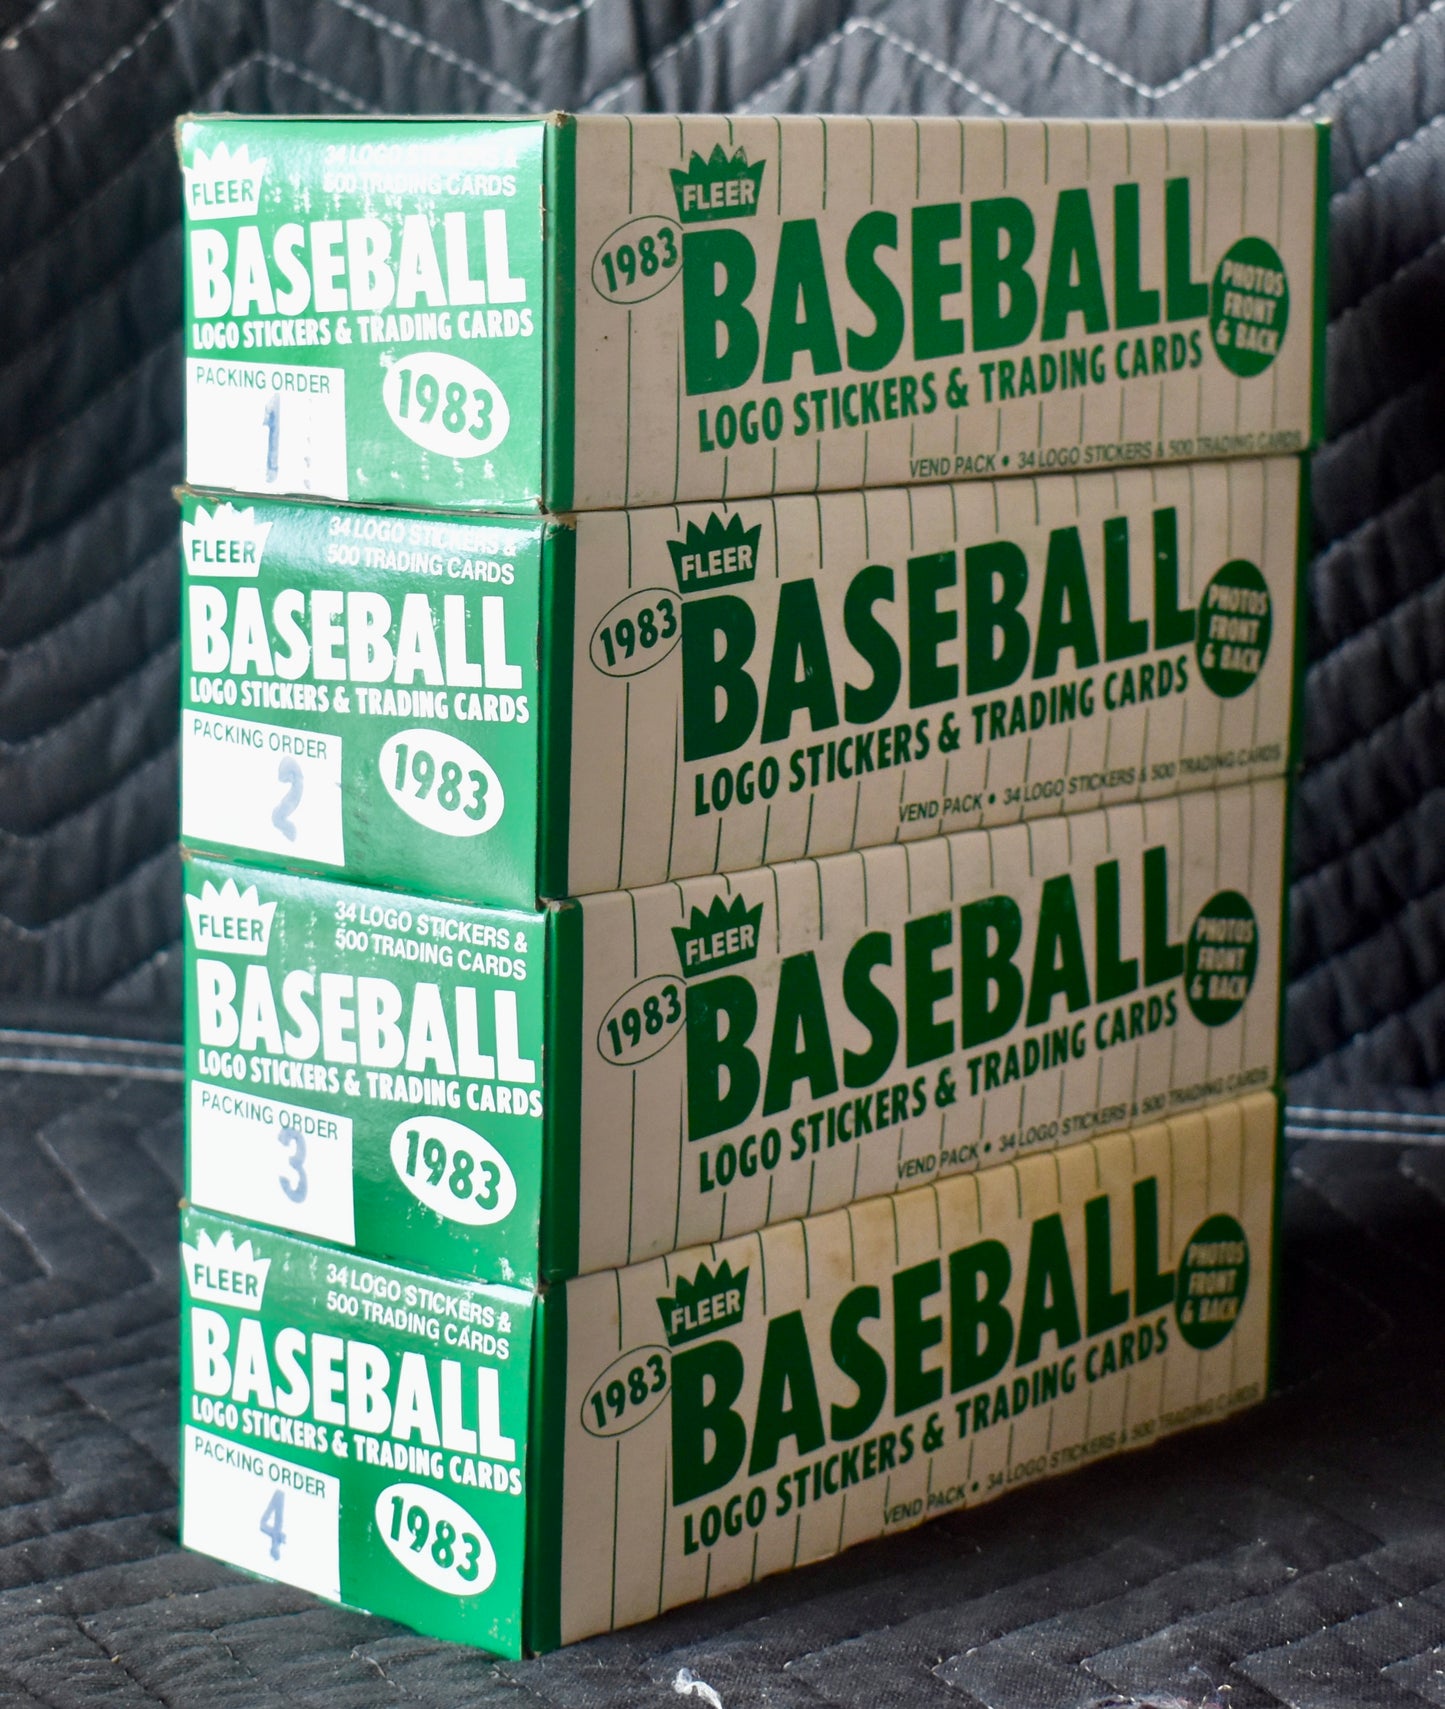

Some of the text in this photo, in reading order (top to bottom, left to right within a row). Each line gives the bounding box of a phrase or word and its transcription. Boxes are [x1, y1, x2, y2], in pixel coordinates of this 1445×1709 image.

[192, 178, 254, 206] FLEER
[446, 173, 517, 197] CARDS
[683, 179, 756, 211] FLEER
[190, 209, 526, 318] BASEBALL
[601, 227, 678, 293] 1983
[682, 177, 1209, 396] BASEBALL
[193, 309, 534, 350] LOGO STICKERS & TRADING CARDS
[1223, 290, 1276, 325] FRONT
[196, 366, 330, 394] PACKING ORDER
[399, 368, 494, 441] 1983
[699, 330, 1203, 452] LOGO STICKERS & TRADING CARDS
[262, 393, 280, 483] 1
[909, 458, 950, 478] VEND
[955, 455, 995, 475] PACK
[1018, 452, 1036, 468] 34
[1038, 448, 1080, 467] LOGO
[1084, 441, 1152, 464] STICKERS
[192, 540, 255, 563] FLEER
[328, 516, 350, 536] 34
[354, 519, 404, 544] LOGO
[681, 545, 753, 581] FLEER
[327, 544, 515, 585] 500 TRADING CARDS
[188, 585, 522, 689] BASEBALL
[600, 598, 677, 668] 1983
[681, 506, 1196, 762] BASEBALL
[190, 677, 530, 724] LOGO STICKERS & TRADING CARDS
[194, 719, 327, 760] PACKING ORDER
[695, 655, 1188, 817] LOGO STICKERS & TRADING CARDS
[271, 756, 304, 842] 2
[394, 743, 489, 821] 1983
[899, 802, 938, 822] VEND
[943, 795, 982, 816] PACK
[1003, 788, 1021, 805] 34
[1023, 780, 1065, 802] LOGO
[1068, 768, 1135, 795] STICKERS
[199, 914, 265, 943] FLEER
[335, 900, 528, 953] 34 LOGO STICKERS &
[335, 932, 527, 981] 500 TRADING CARDS
[685, 924, 755, 966] FLEER
[196, 958, 536, 1084] BASEBALL
[607, 984, 682, 1057] 1983
[685, 845, 1185, 1142] BASEBALL
[199, 1049, 543, 1117] LOGO STICKERS & TRADING CARDS
[202, 1090, 338, 1140] PACKING ORDER
[699, 988, 1177, 1193] LOGO STICKERS & TRADING CARDS
[277, 1127, 308, 1204] 3
[406, 1130, 501, 1211] 1983
[897, 1154, 936, 1178] VEND
[939, 1142, 980, 1168] PACK
[999, 1136, 1017, 1152] 34
[1018, 1124, 1059, 1148] LOGO
[194, 1264, 259, 1297] FLEER
[327, 1264, 512, 1333] 34 LOGO STICKERS &
[670, 1289, 741, 1335] FLEER
[328, 1292, 509, 1360] 500 TRADING CARDS
[671, 1176, 1175, 1507] BASEBALL
[191, 1306, 517, 1461] BASEBALL
[590, 1354, 667, 1428] 1983
[193, 1394, 522, 1496] LOGO STICKERS & TRADING CARDS
[195, 1438, 326, 1499] PACKING ORDER
[684, 1317, 1169, 1556] LOGO STICKERS & TRADING CARDS
[259, 1489, 286, 1560] 4
[883, 1499, 923, 1524] VEND
[927, 1485, 966, 1513] PACK
[987, 1471, 1005, 1490] 34
[1006, 1458, 1048, 1484] LOGO
[391, 1495, 481, 1582] 1983
